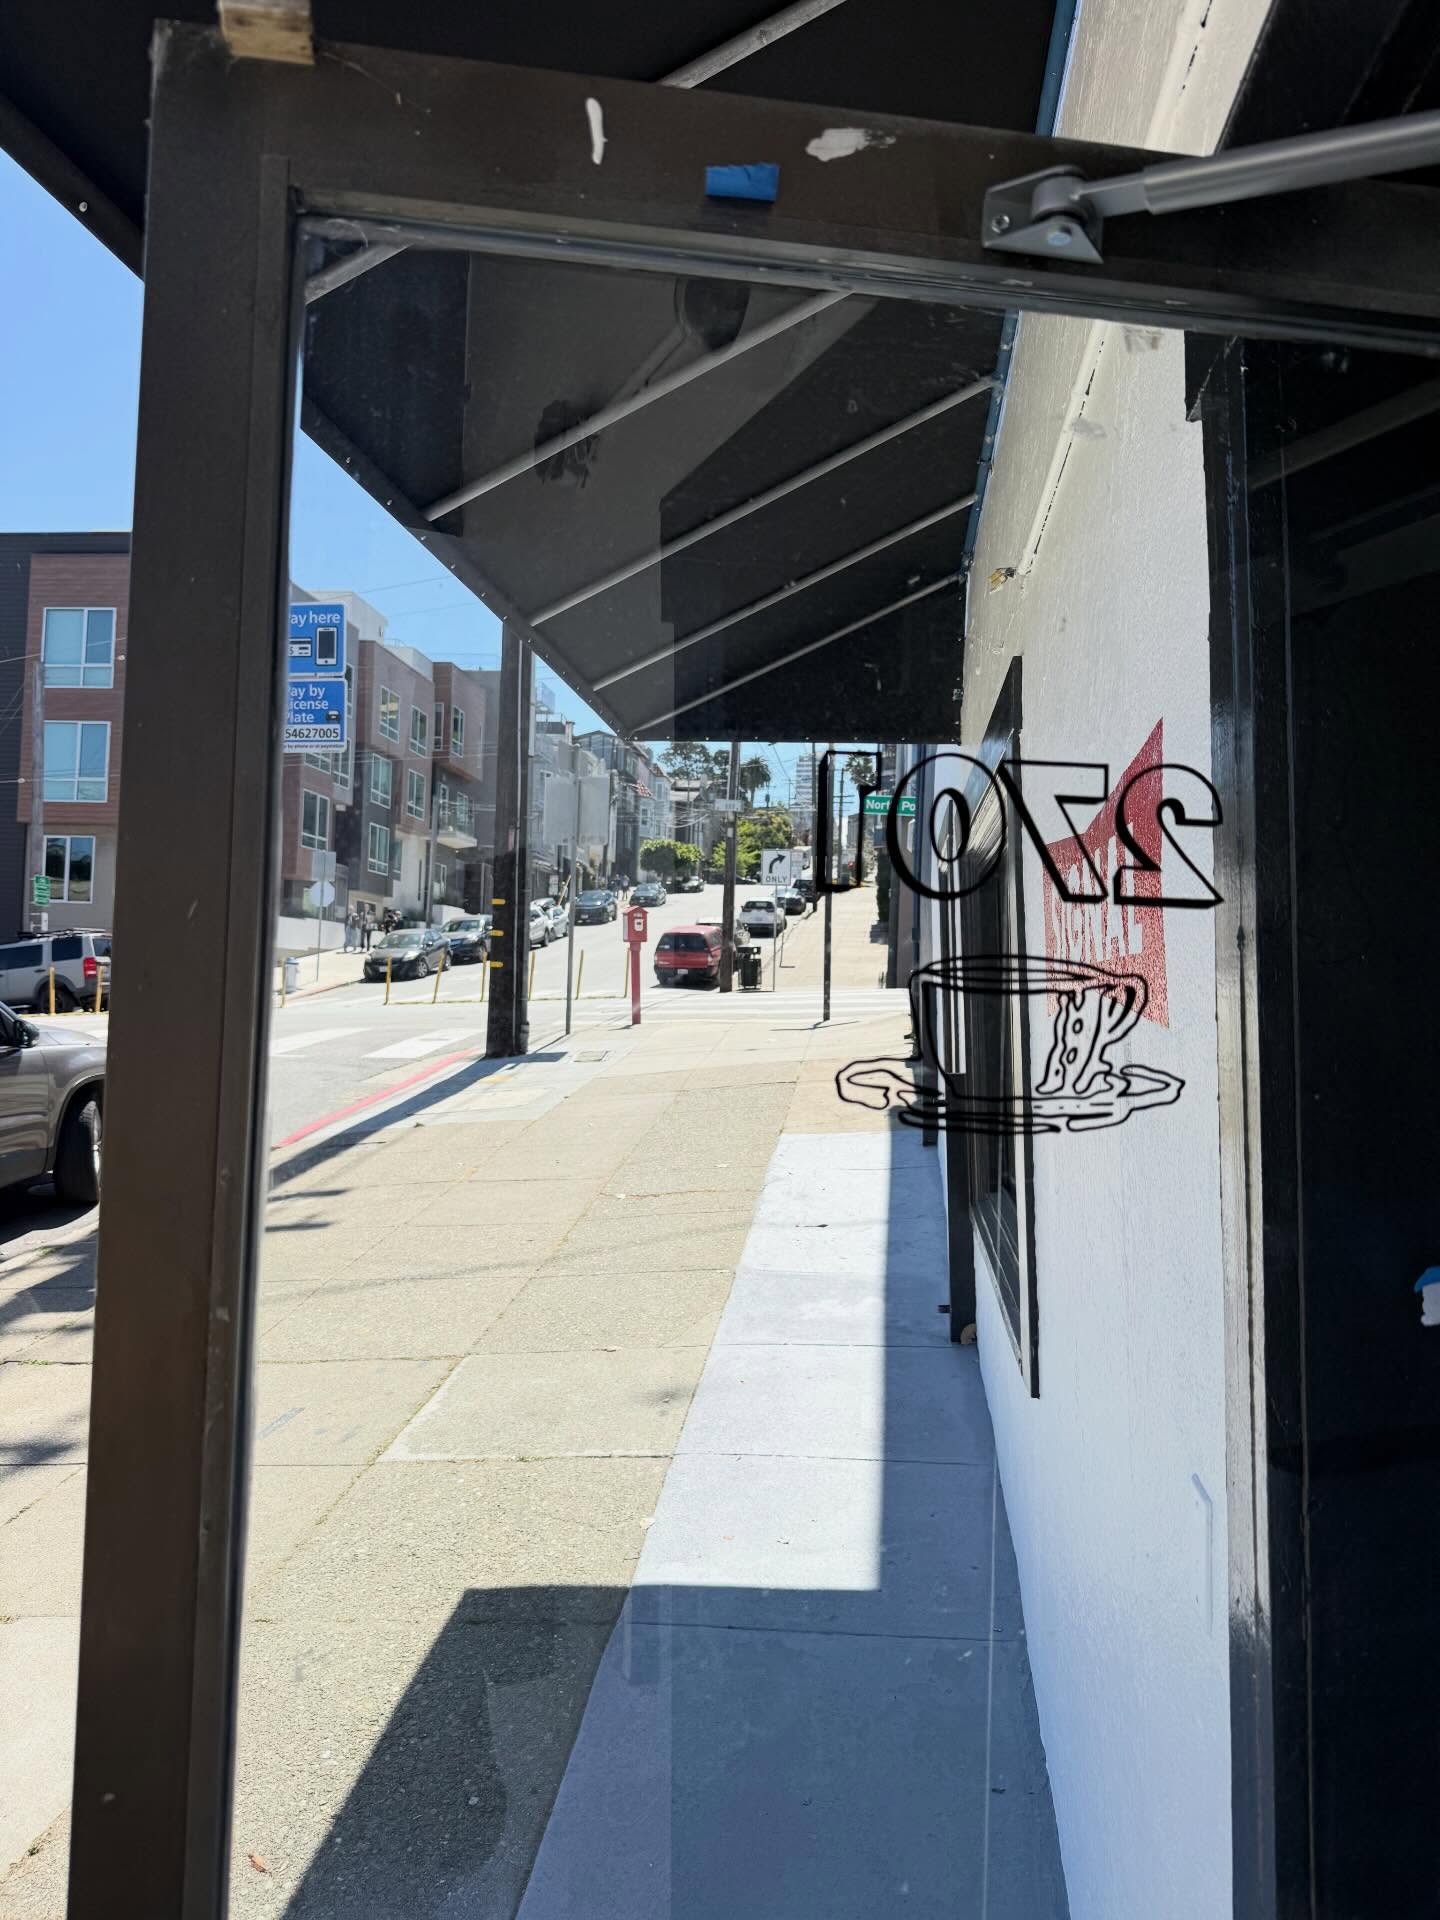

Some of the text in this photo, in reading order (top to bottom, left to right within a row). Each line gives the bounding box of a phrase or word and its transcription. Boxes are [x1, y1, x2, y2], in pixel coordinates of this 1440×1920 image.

[289, 610, 341, 627] ay here
[309, 684, 326, 700] by
[287, 698, 329, 710] icense
[765, 874, 788, 884] ONLY
